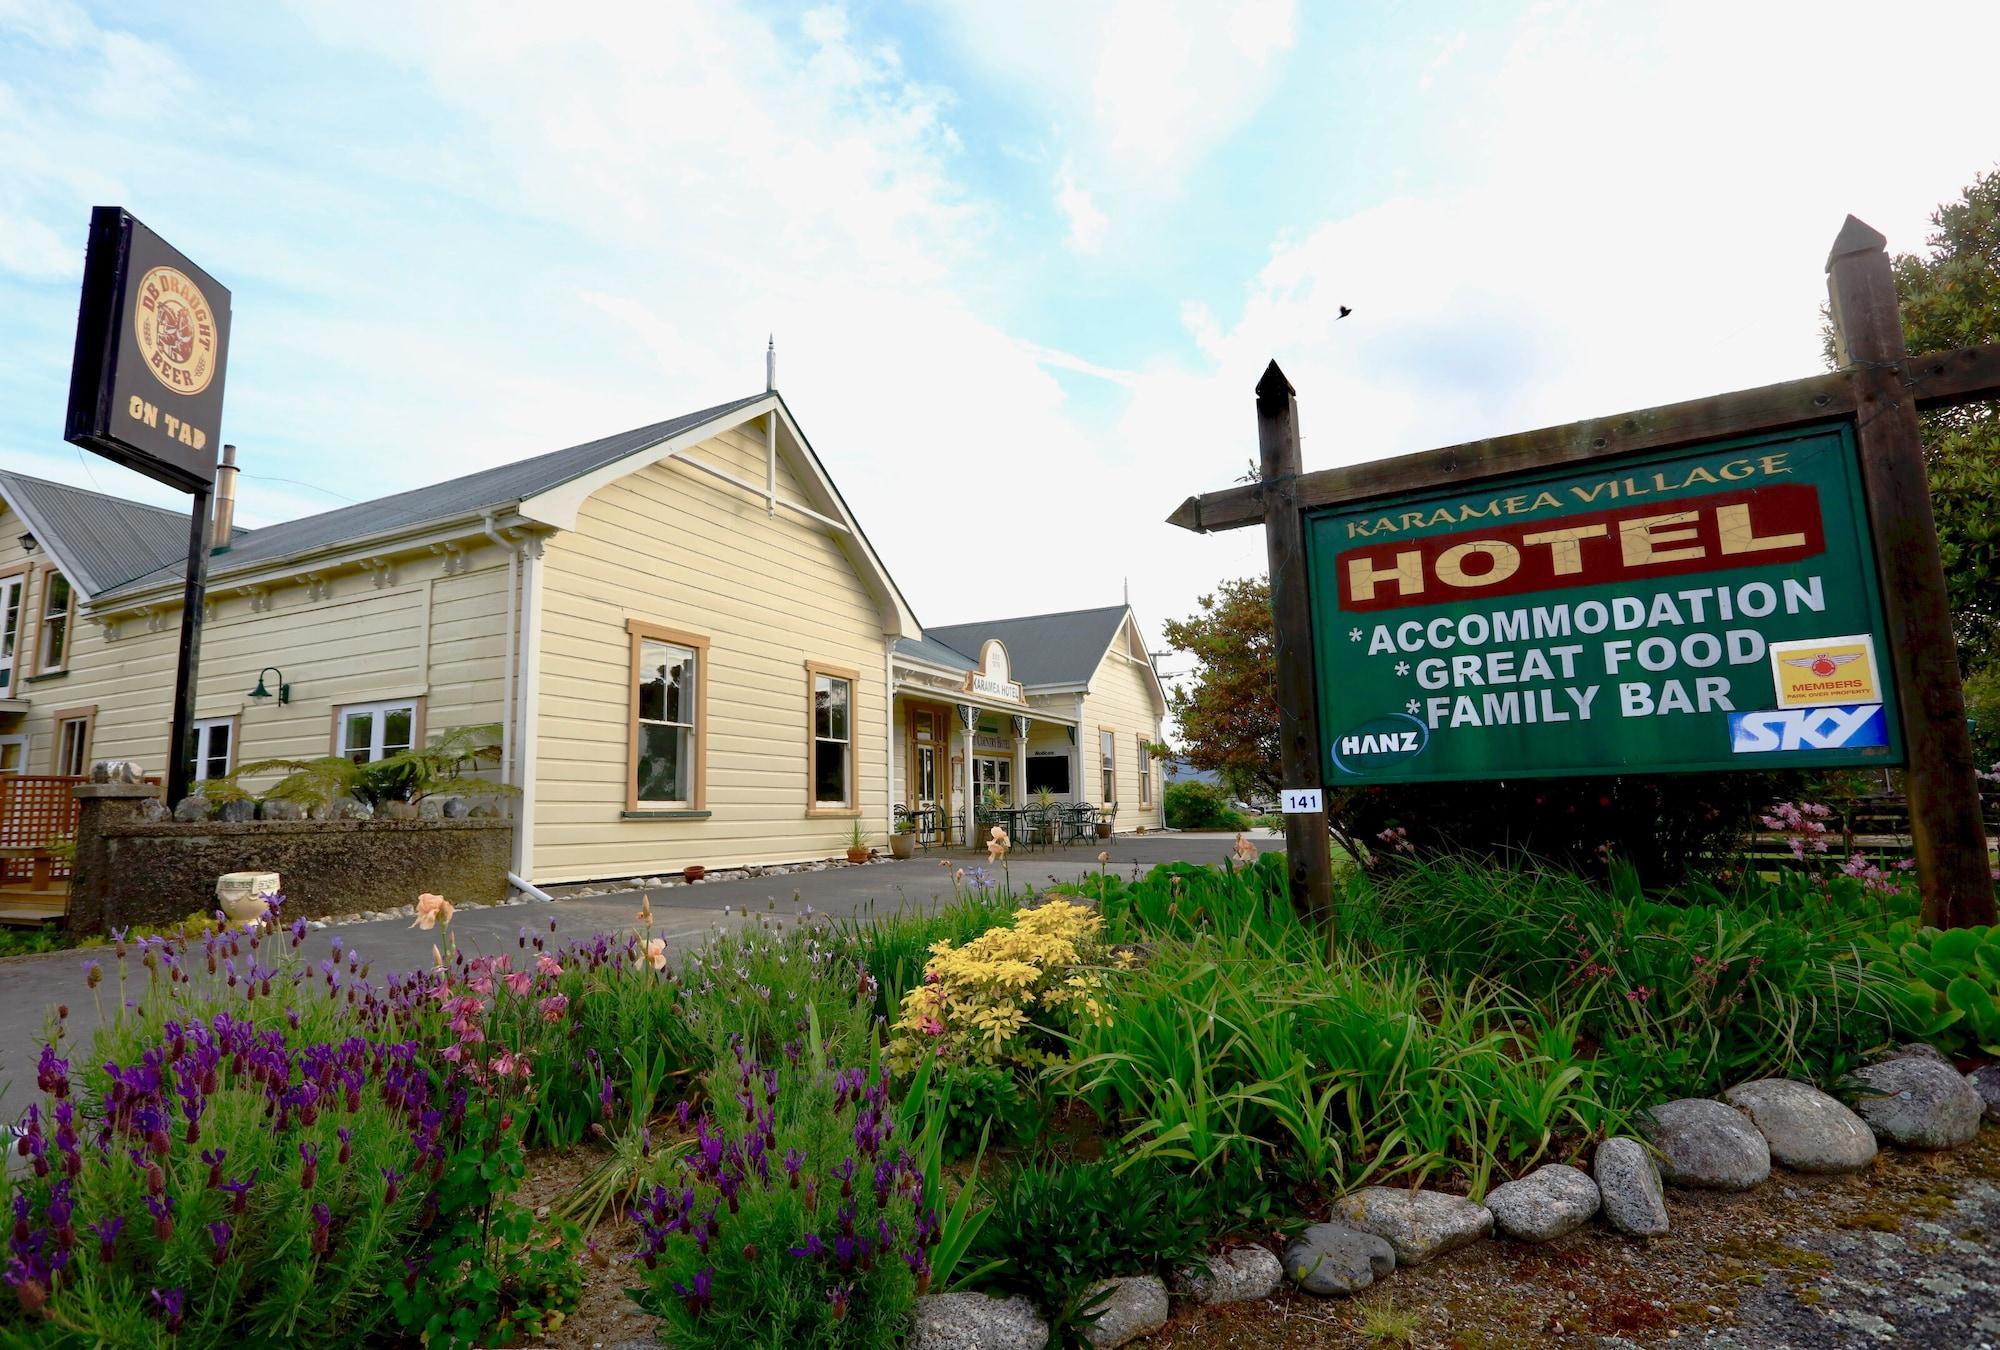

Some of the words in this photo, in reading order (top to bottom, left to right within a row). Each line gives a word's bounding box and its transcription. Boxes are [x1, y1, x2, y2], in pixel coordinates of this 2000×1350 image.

[142, 282, 160, 312] DB
[159, 275, 211, 352] DRAUGHT
[151, 350, 194, 386] BEER
[128, 395, 158, 428] ON
[164, 413, 206, 450] TAP
[1346, 491, 1565, 539] KARAMEA
[1569, 452, 1790, 503] VILLAGE
[1348, 503, 1806, 602] HOTEL
[1603, 629, 1766, 675] FOOD
[973, 677, 1000, 695] KARAMEA
[1001, 685, 1019, 699] HOTEL
[1619, 676, 1737, 718] BAR
[1792, 679, 1863, 692] MEMBERS
[1831, 688, 1871, 696] PROPERTY
[1341, 731, 1419, 756] HANZ
[1732, 704, 1883, 753] SKY
[1290, 795, 1317, 809] 141
